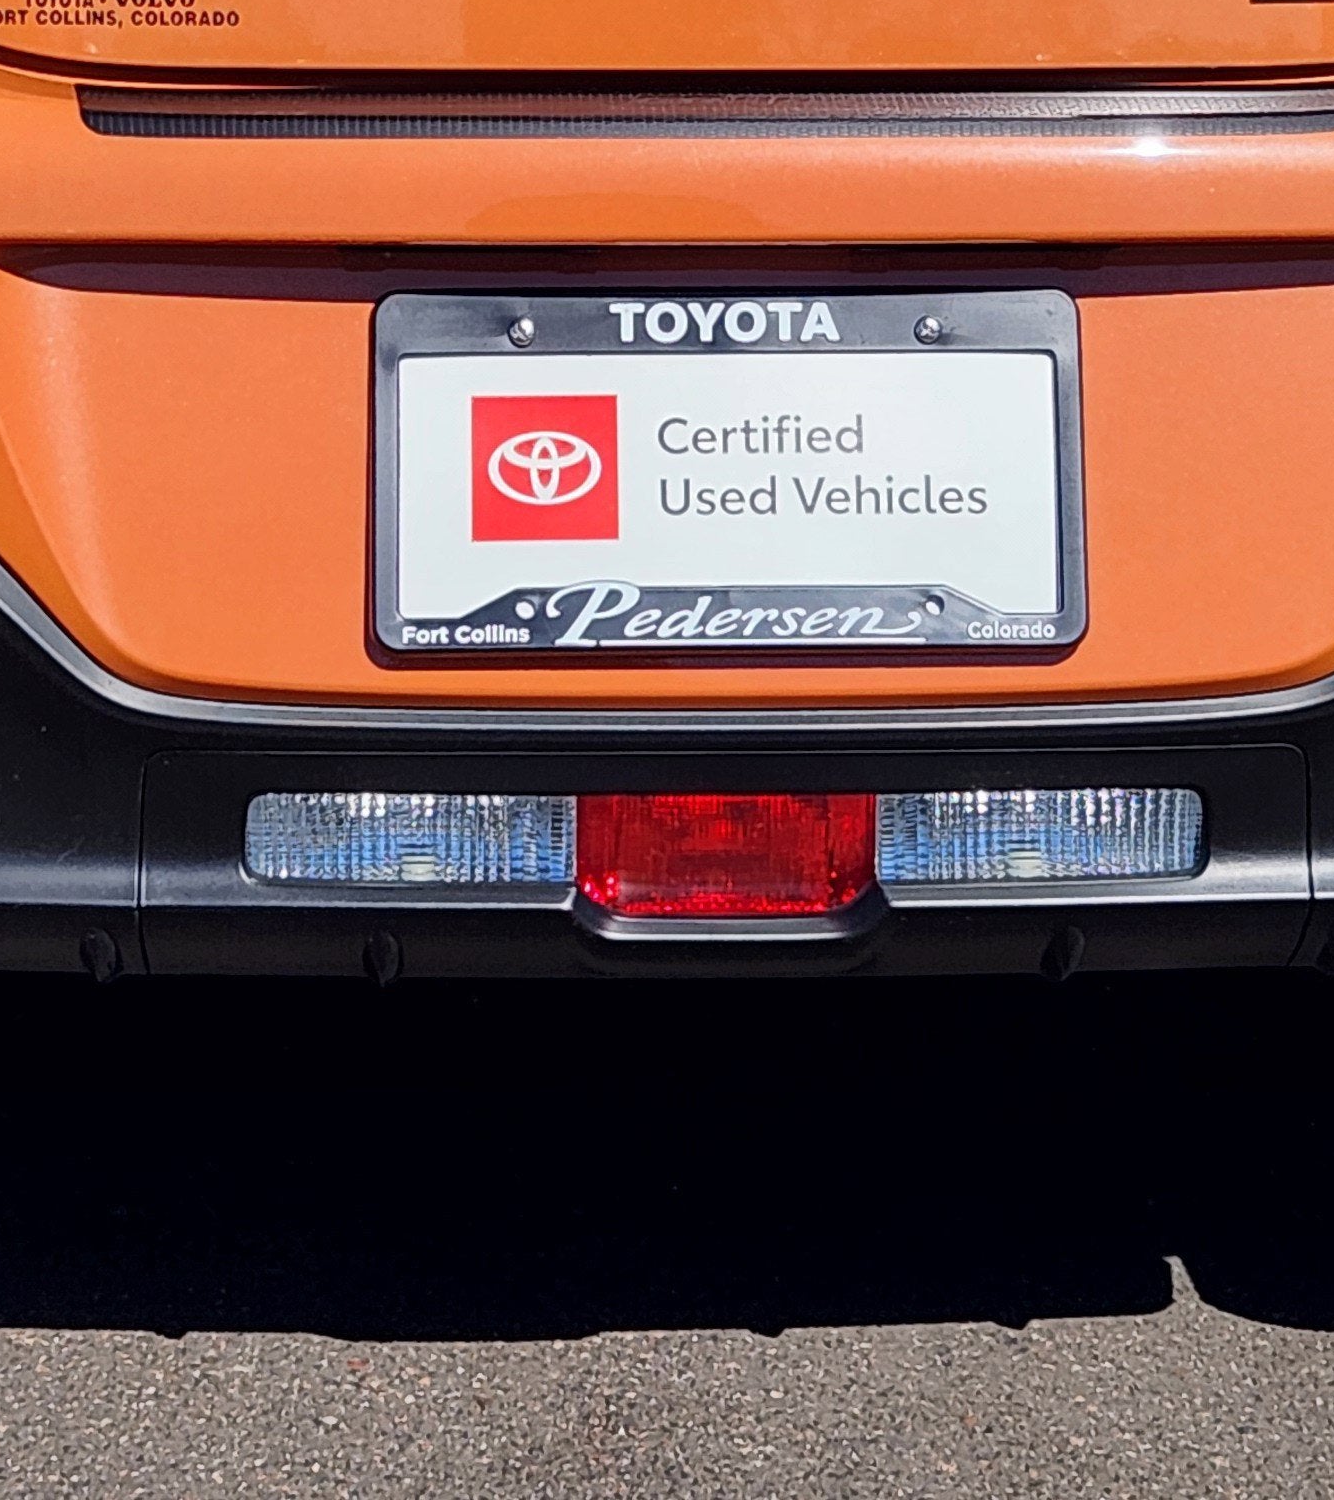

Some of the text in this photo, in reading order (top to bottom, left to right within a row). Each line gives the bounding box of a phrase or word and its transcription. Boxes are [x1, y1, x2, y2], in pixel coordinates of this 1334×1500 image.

[35, 10, 124, 29] COLLINS,
[130, 10, 240, 27] COLORADO
[609, 301, 841, 344] TOYOTA
[657, 414, 865, 455] Certified
[659, 475, 988, 516] Used Vehicles
[401, 623, 531, 645] Fort Collins
[545, 580, 923, 647] Pedersen
[967, 620, 1057, 639] Colorado
